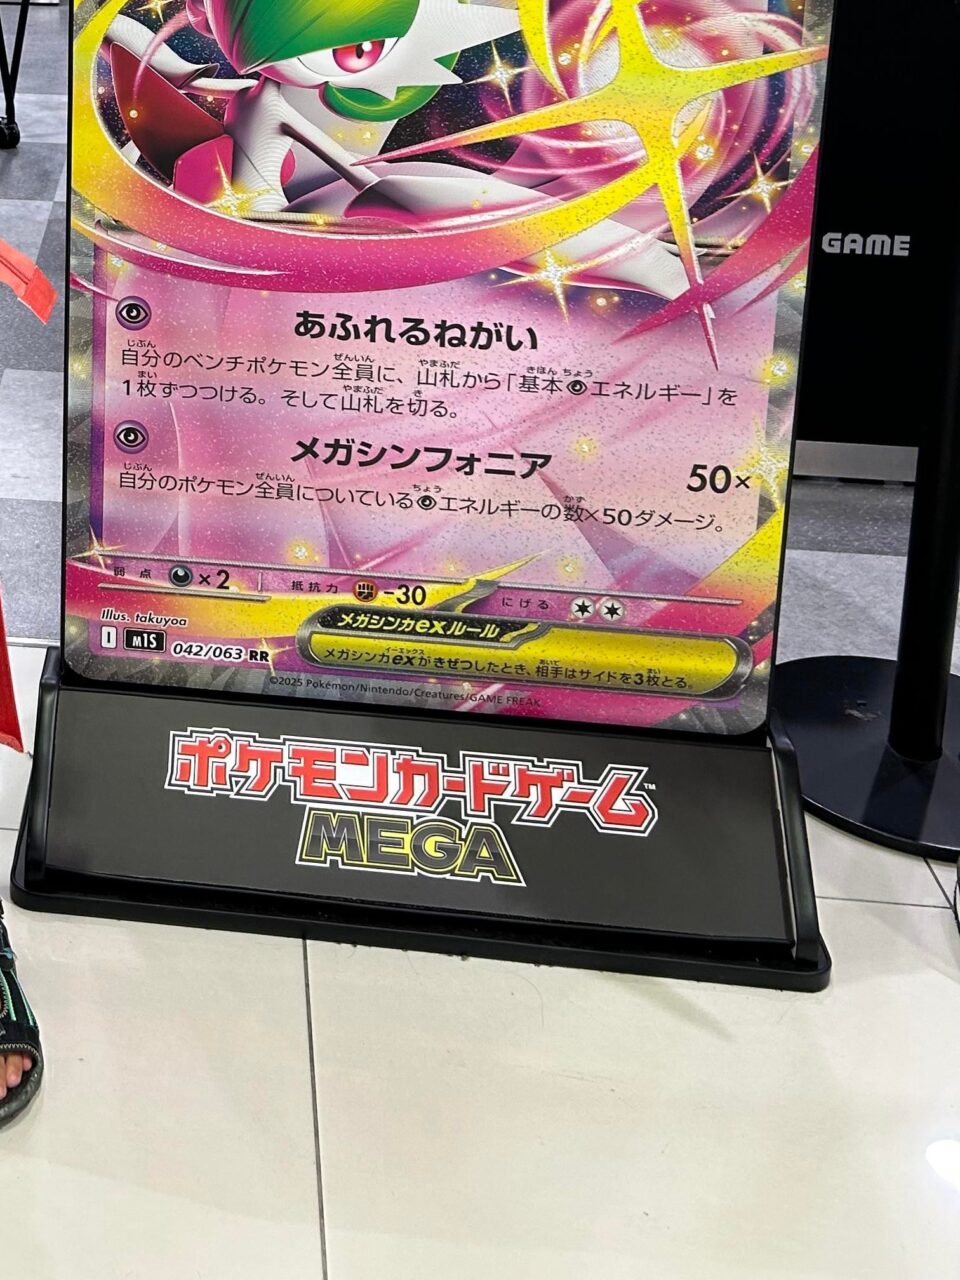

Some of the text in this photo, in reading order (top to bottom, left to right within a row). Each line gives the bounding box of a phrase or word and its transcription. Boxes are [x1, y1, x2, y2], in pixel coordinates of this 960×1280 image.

[822, 232, 911, 256] GAME
[294, 310, 538, 352] あふれるねがい
[291, 437, 552, 480] メガシンフォニア
[101, 609, 187, 628] Illus. takuyoa
[337, 612, 501, 638] メガシンカexルール
[173, 643, 243, 660] 042/063
[249, 650, 270, 663] RR
[506, 695, 541, 707] FREAK
[166, 728, 657, 836] ポケモンカードゲーム
[296, 807, 525, 886] MEGA
